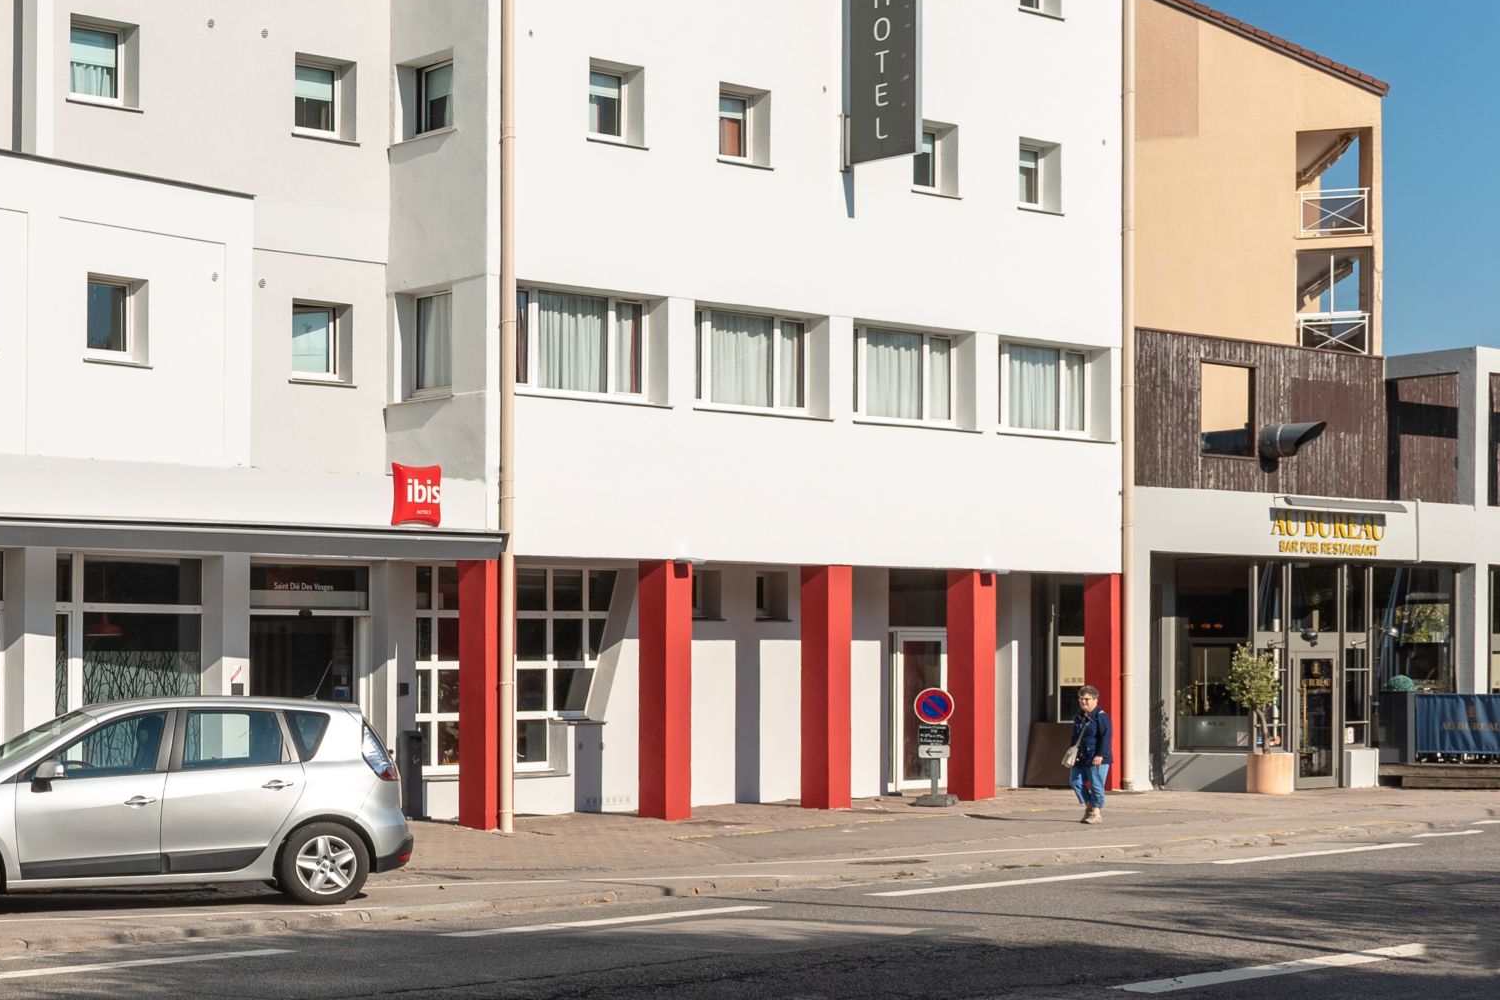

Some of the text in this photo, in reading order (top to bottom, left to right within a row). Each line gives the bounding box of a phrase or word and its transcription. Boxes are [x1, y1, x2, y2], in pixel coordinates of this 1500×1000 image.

[407, 479, 441, 504] ibis
[1270, 510, 1386, 541] AU BUREAU
[1279, 540, 1379, 556] BAR PUB RESTAURANT
[274, 582, 289, 590] Saint
[314, 583, 334, 592] Vosges
